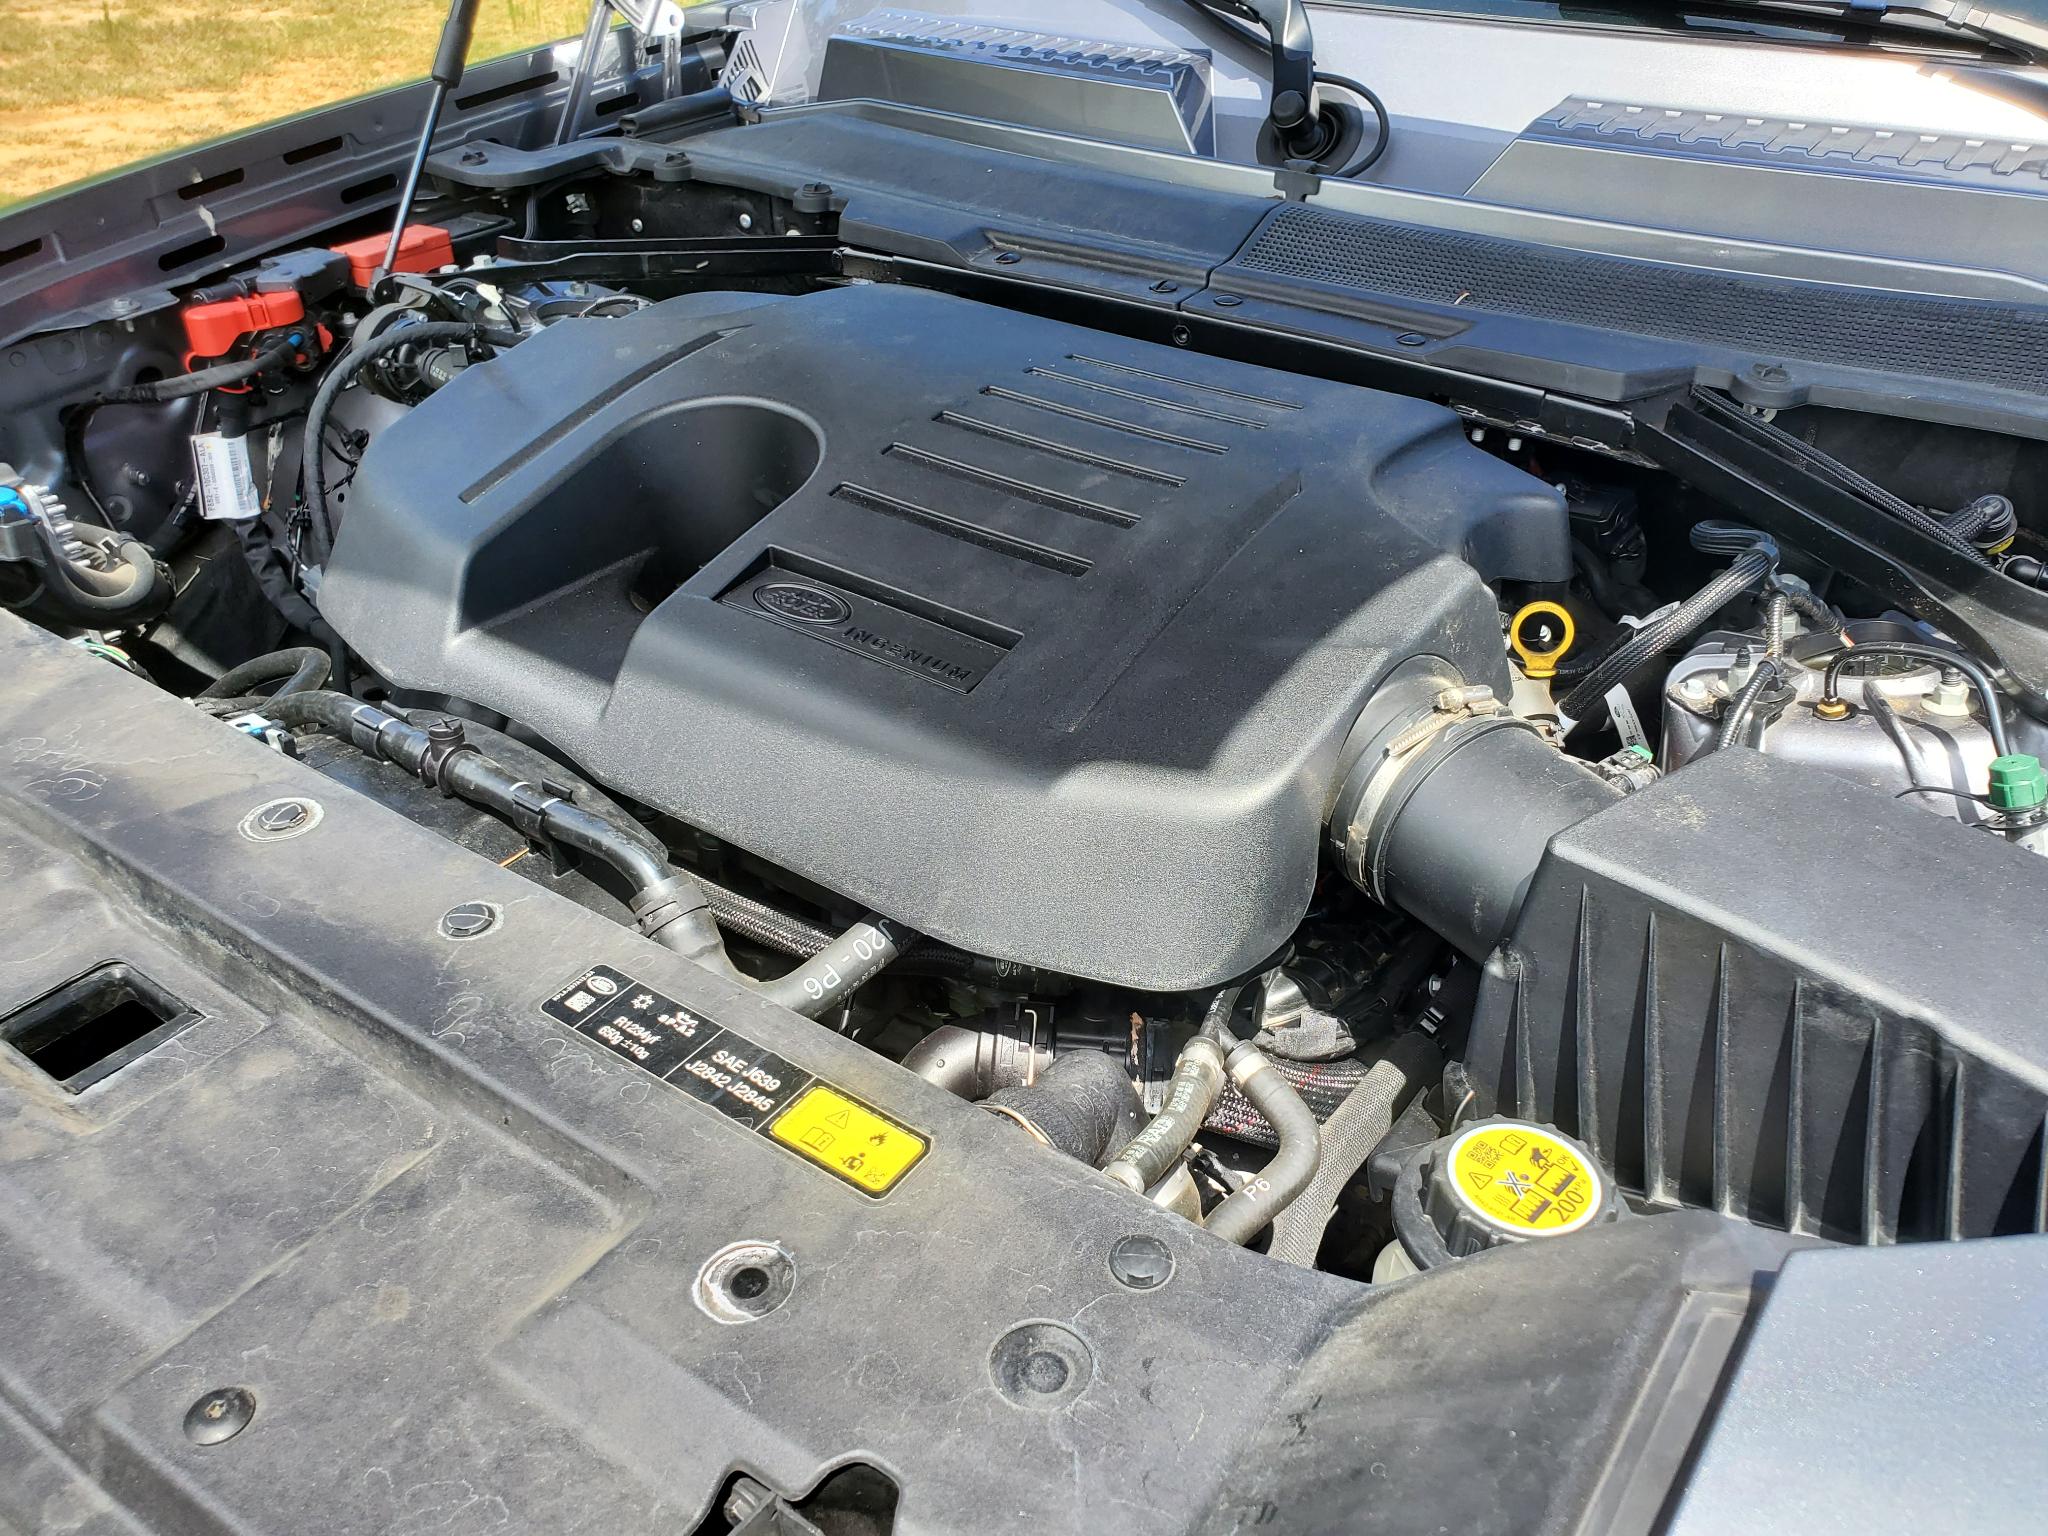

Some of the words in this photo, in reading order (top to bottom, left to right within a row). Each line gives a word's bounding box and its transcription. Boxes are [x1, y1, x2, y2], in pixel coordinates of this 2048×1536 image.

[841, 625, 973, 682] INGENIUM
[597, 1025, 623, 1048] 650g
[613, 1015, 662, 1047] R1234yf
[685, 1060, 735, 1090] J2842
[726, 1082, 775, 1112] J2845
[712, 1049, 744, 1075] SAE
[741, 1064, 781, 1092] J639
[1242, 1178, 1271, 1202] P6
[1549, 1190, 1585, 1222] 200
